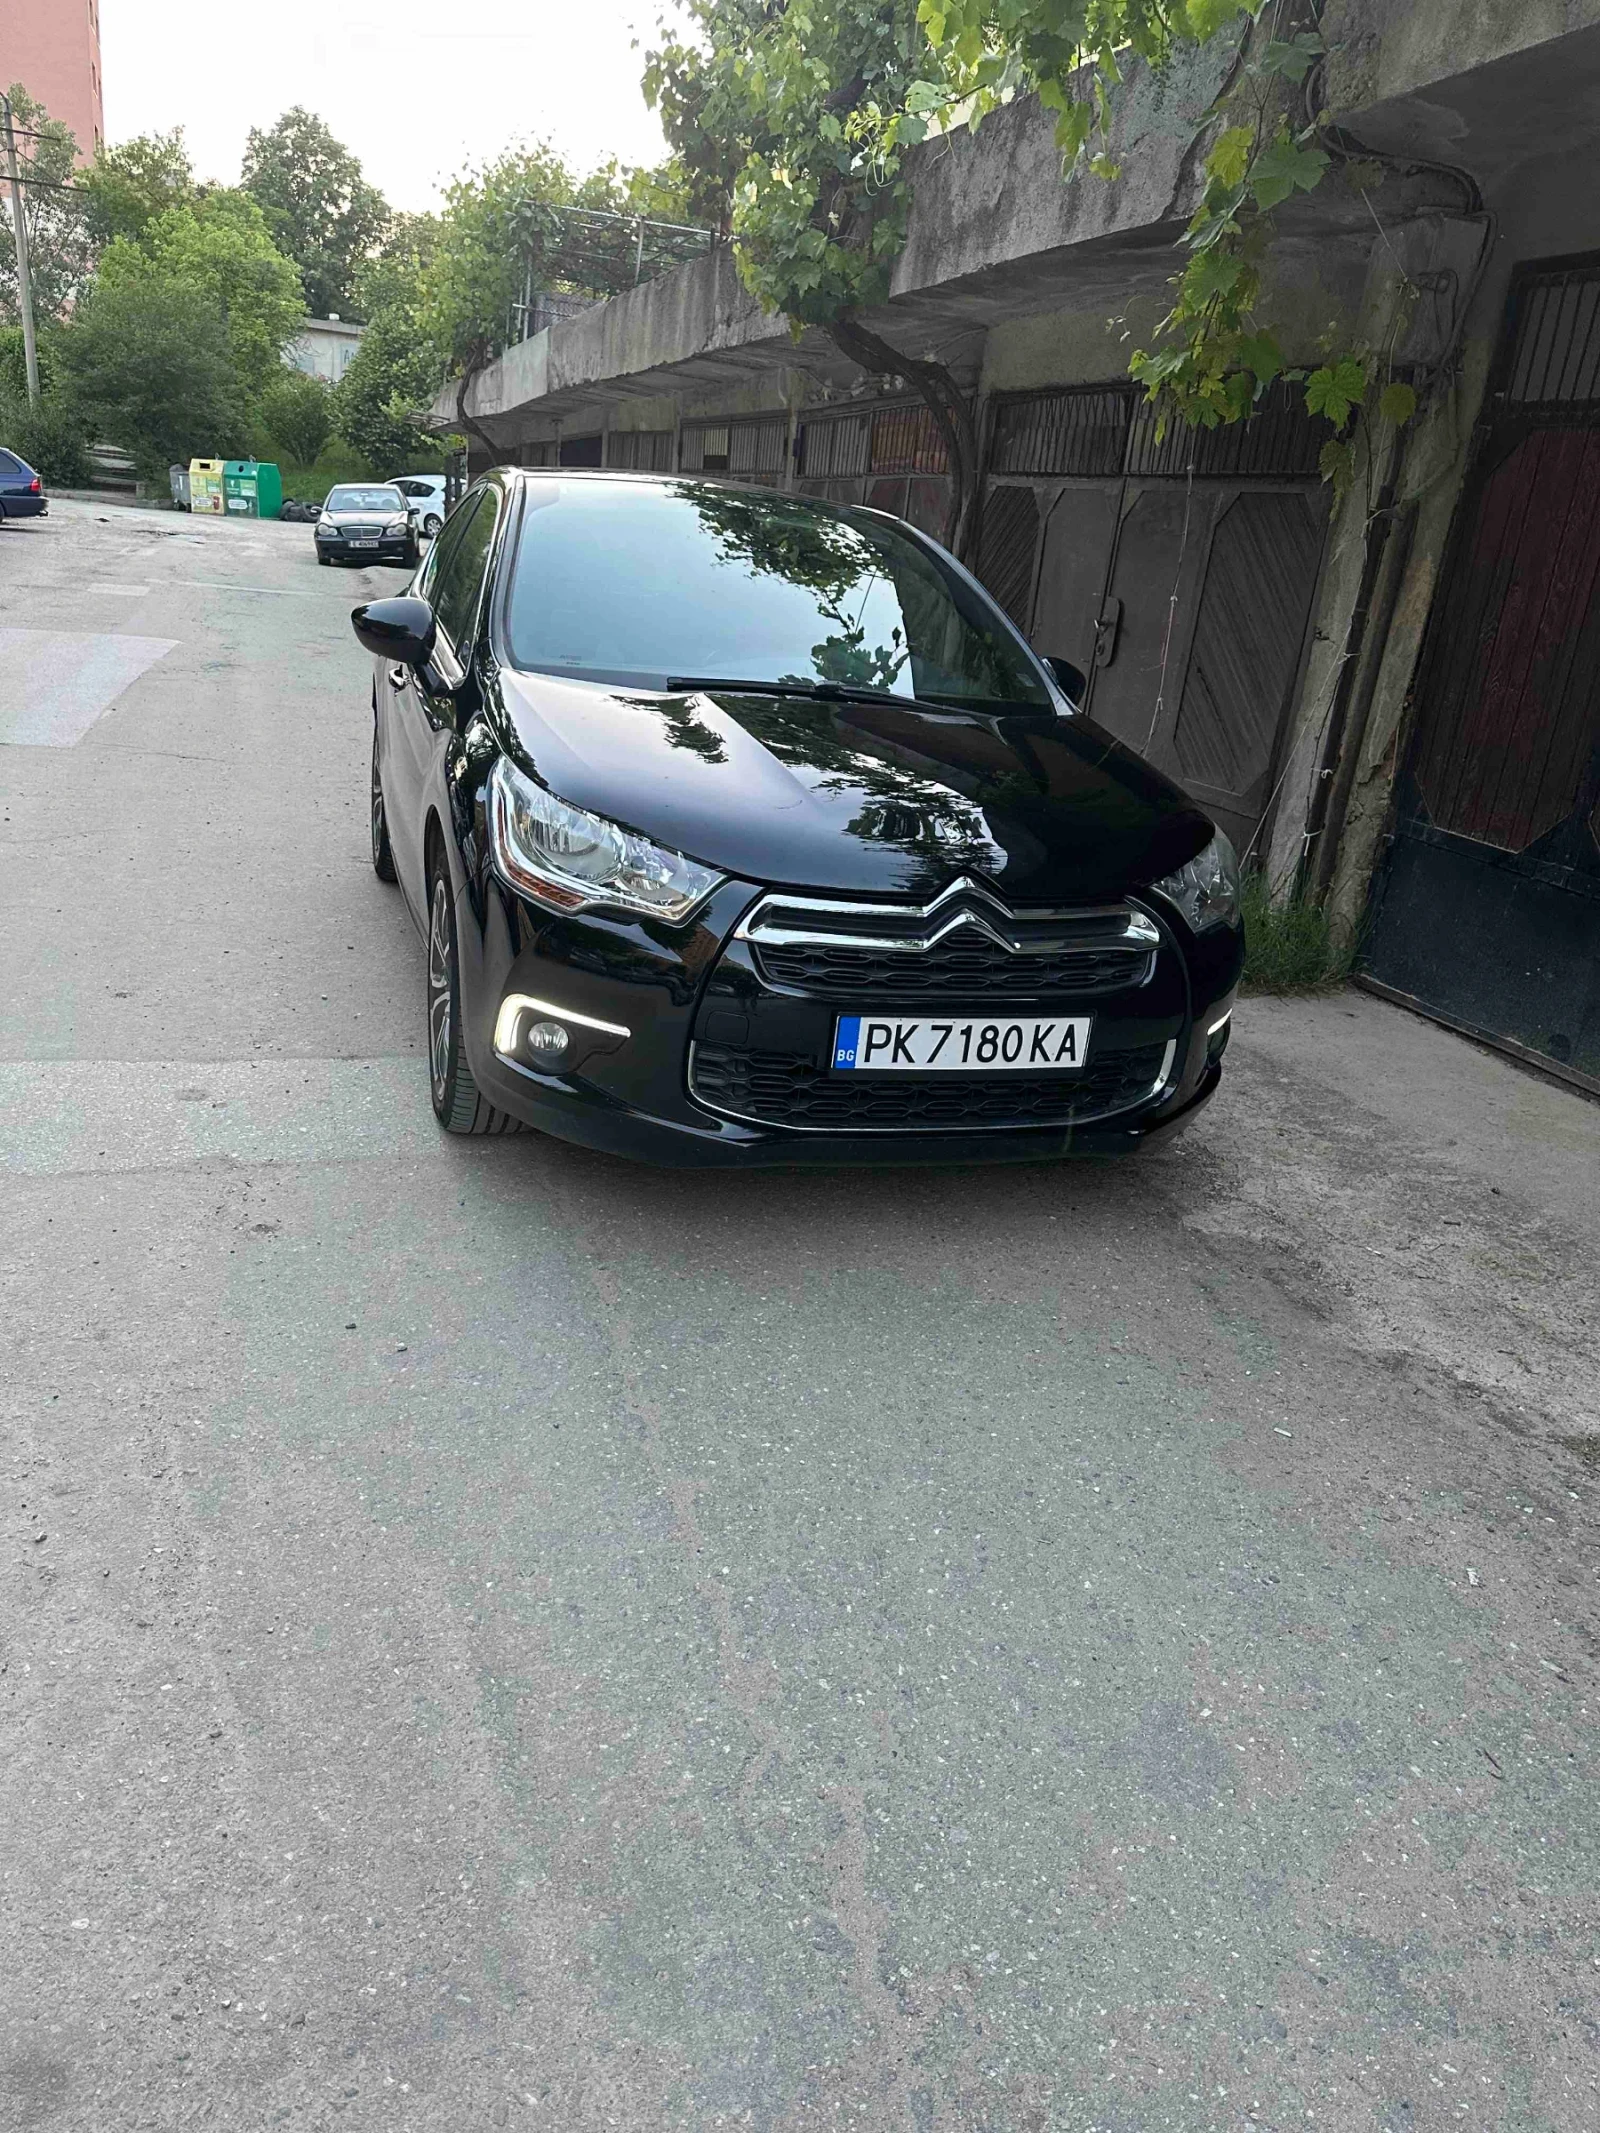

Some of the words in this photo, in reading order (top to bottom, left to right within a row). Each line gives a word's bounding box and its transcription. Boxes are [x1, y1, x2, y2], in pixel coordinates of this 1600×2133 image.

[836, 1049, 855, 1061] BG
[863, 1023, 920, 1063] PK
[926, 1024, 1024, 1063] 7180
[1029, 1023, 1077, 1063] KA
